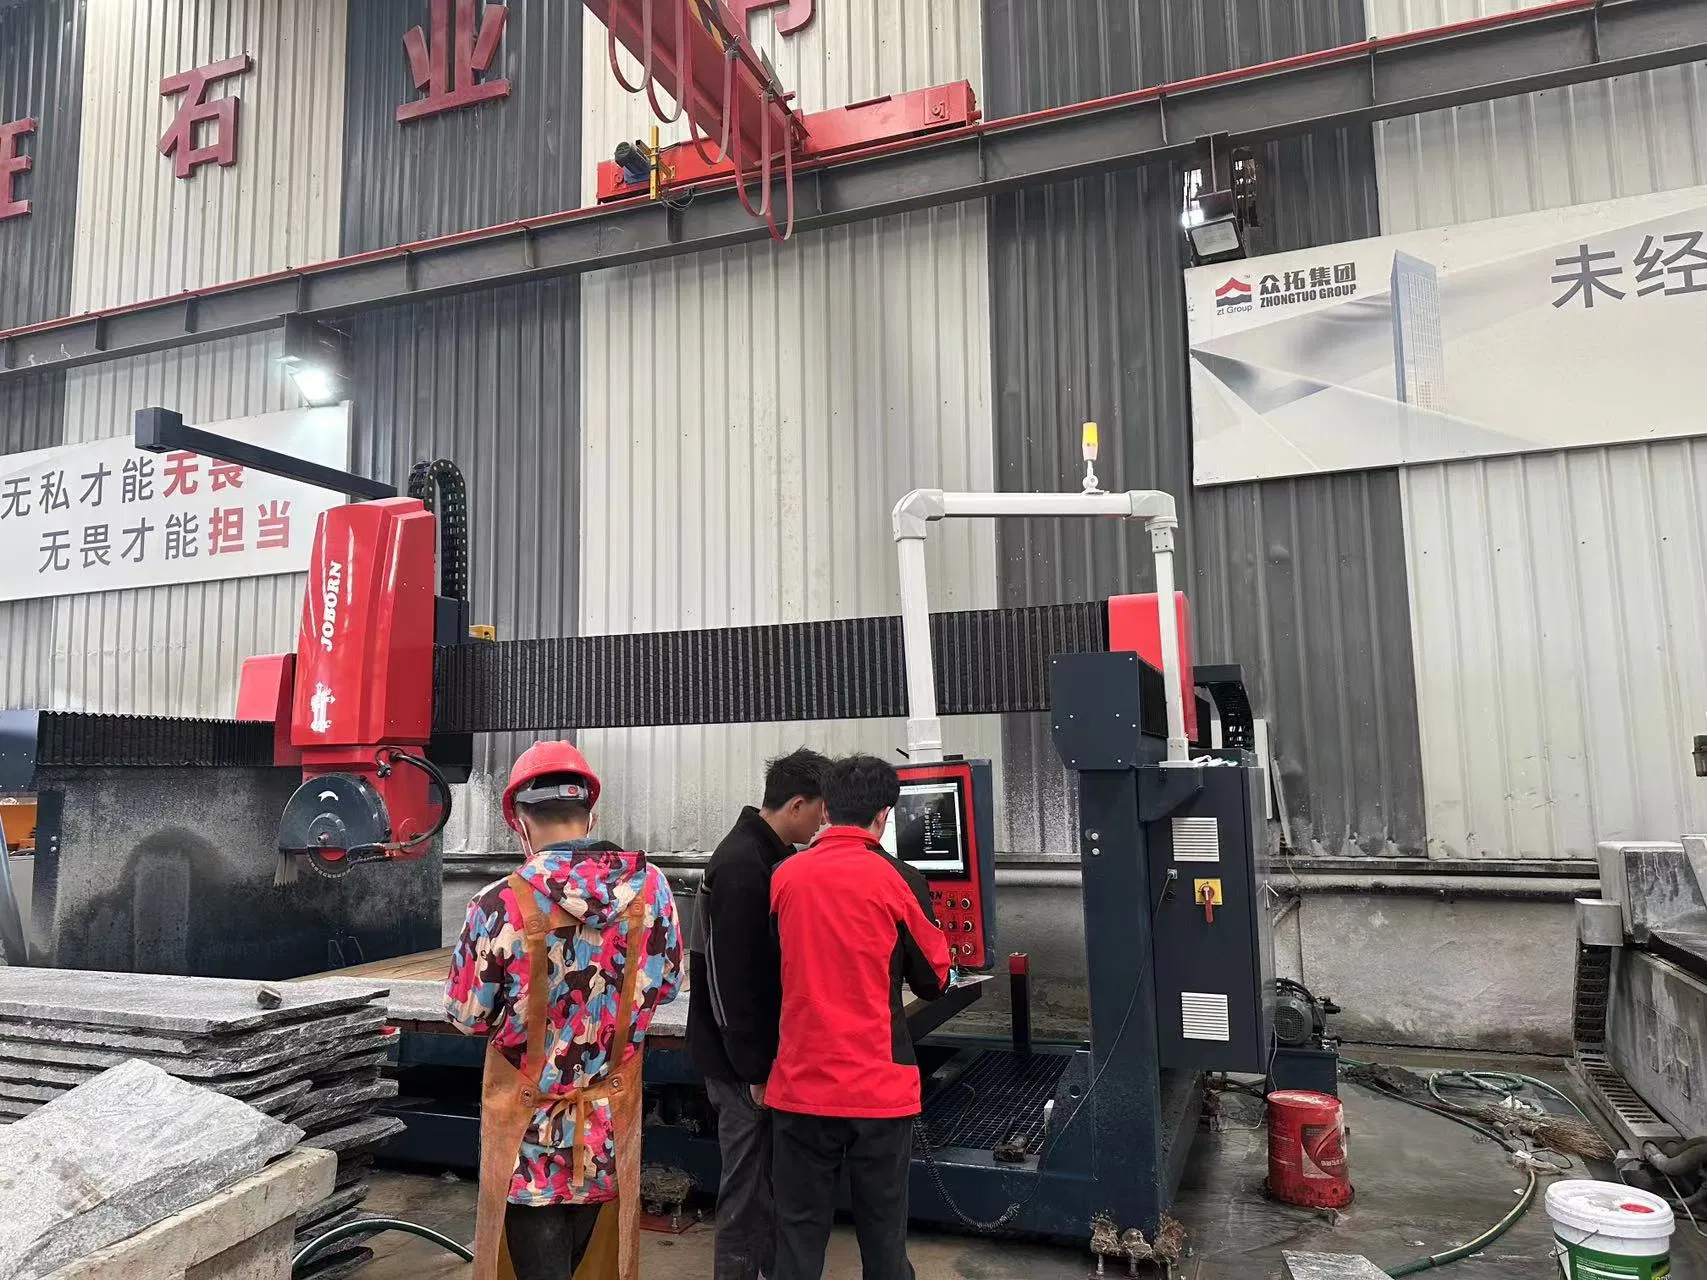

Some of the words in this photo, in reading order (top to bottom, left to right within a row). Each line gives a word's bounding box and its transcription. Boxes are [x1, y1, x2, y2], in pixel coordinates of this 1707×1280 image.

[1259, 262, 1356, 295] 众拓集团
[1260, 291, 1317, 308] ZHONGTUO
[1319, 283, 1357, 299] GROUP
[1551, 231, 1707, 308] 未经
[1227, 305, 1252, 314] Group
[38, 499, 291, 574] 无畏才能担当
[320, 560, 343, 652] JOBORN
